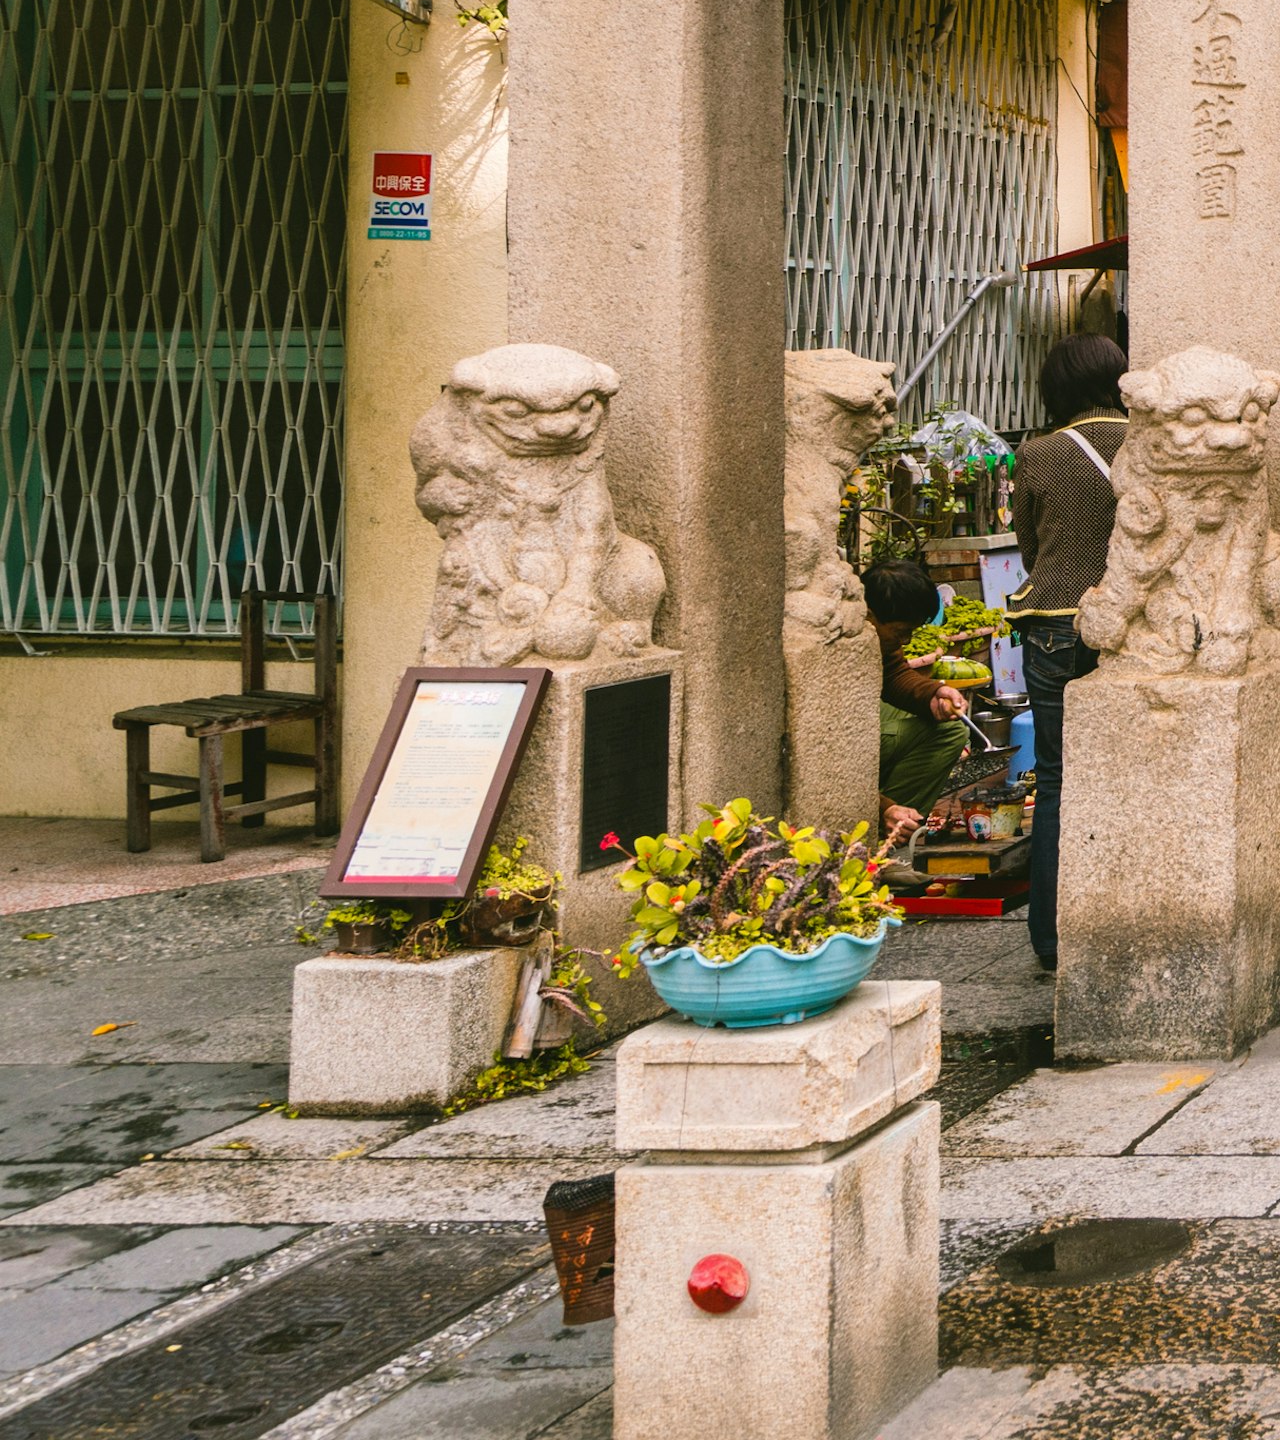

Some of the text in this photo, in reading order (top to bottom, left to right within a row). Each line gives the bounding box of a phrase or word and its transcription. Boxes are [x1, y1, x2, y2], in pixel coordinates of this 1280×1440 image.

[375, 175, 426, 192] 中興保全
[374, 201, 425, 216] SECOM
